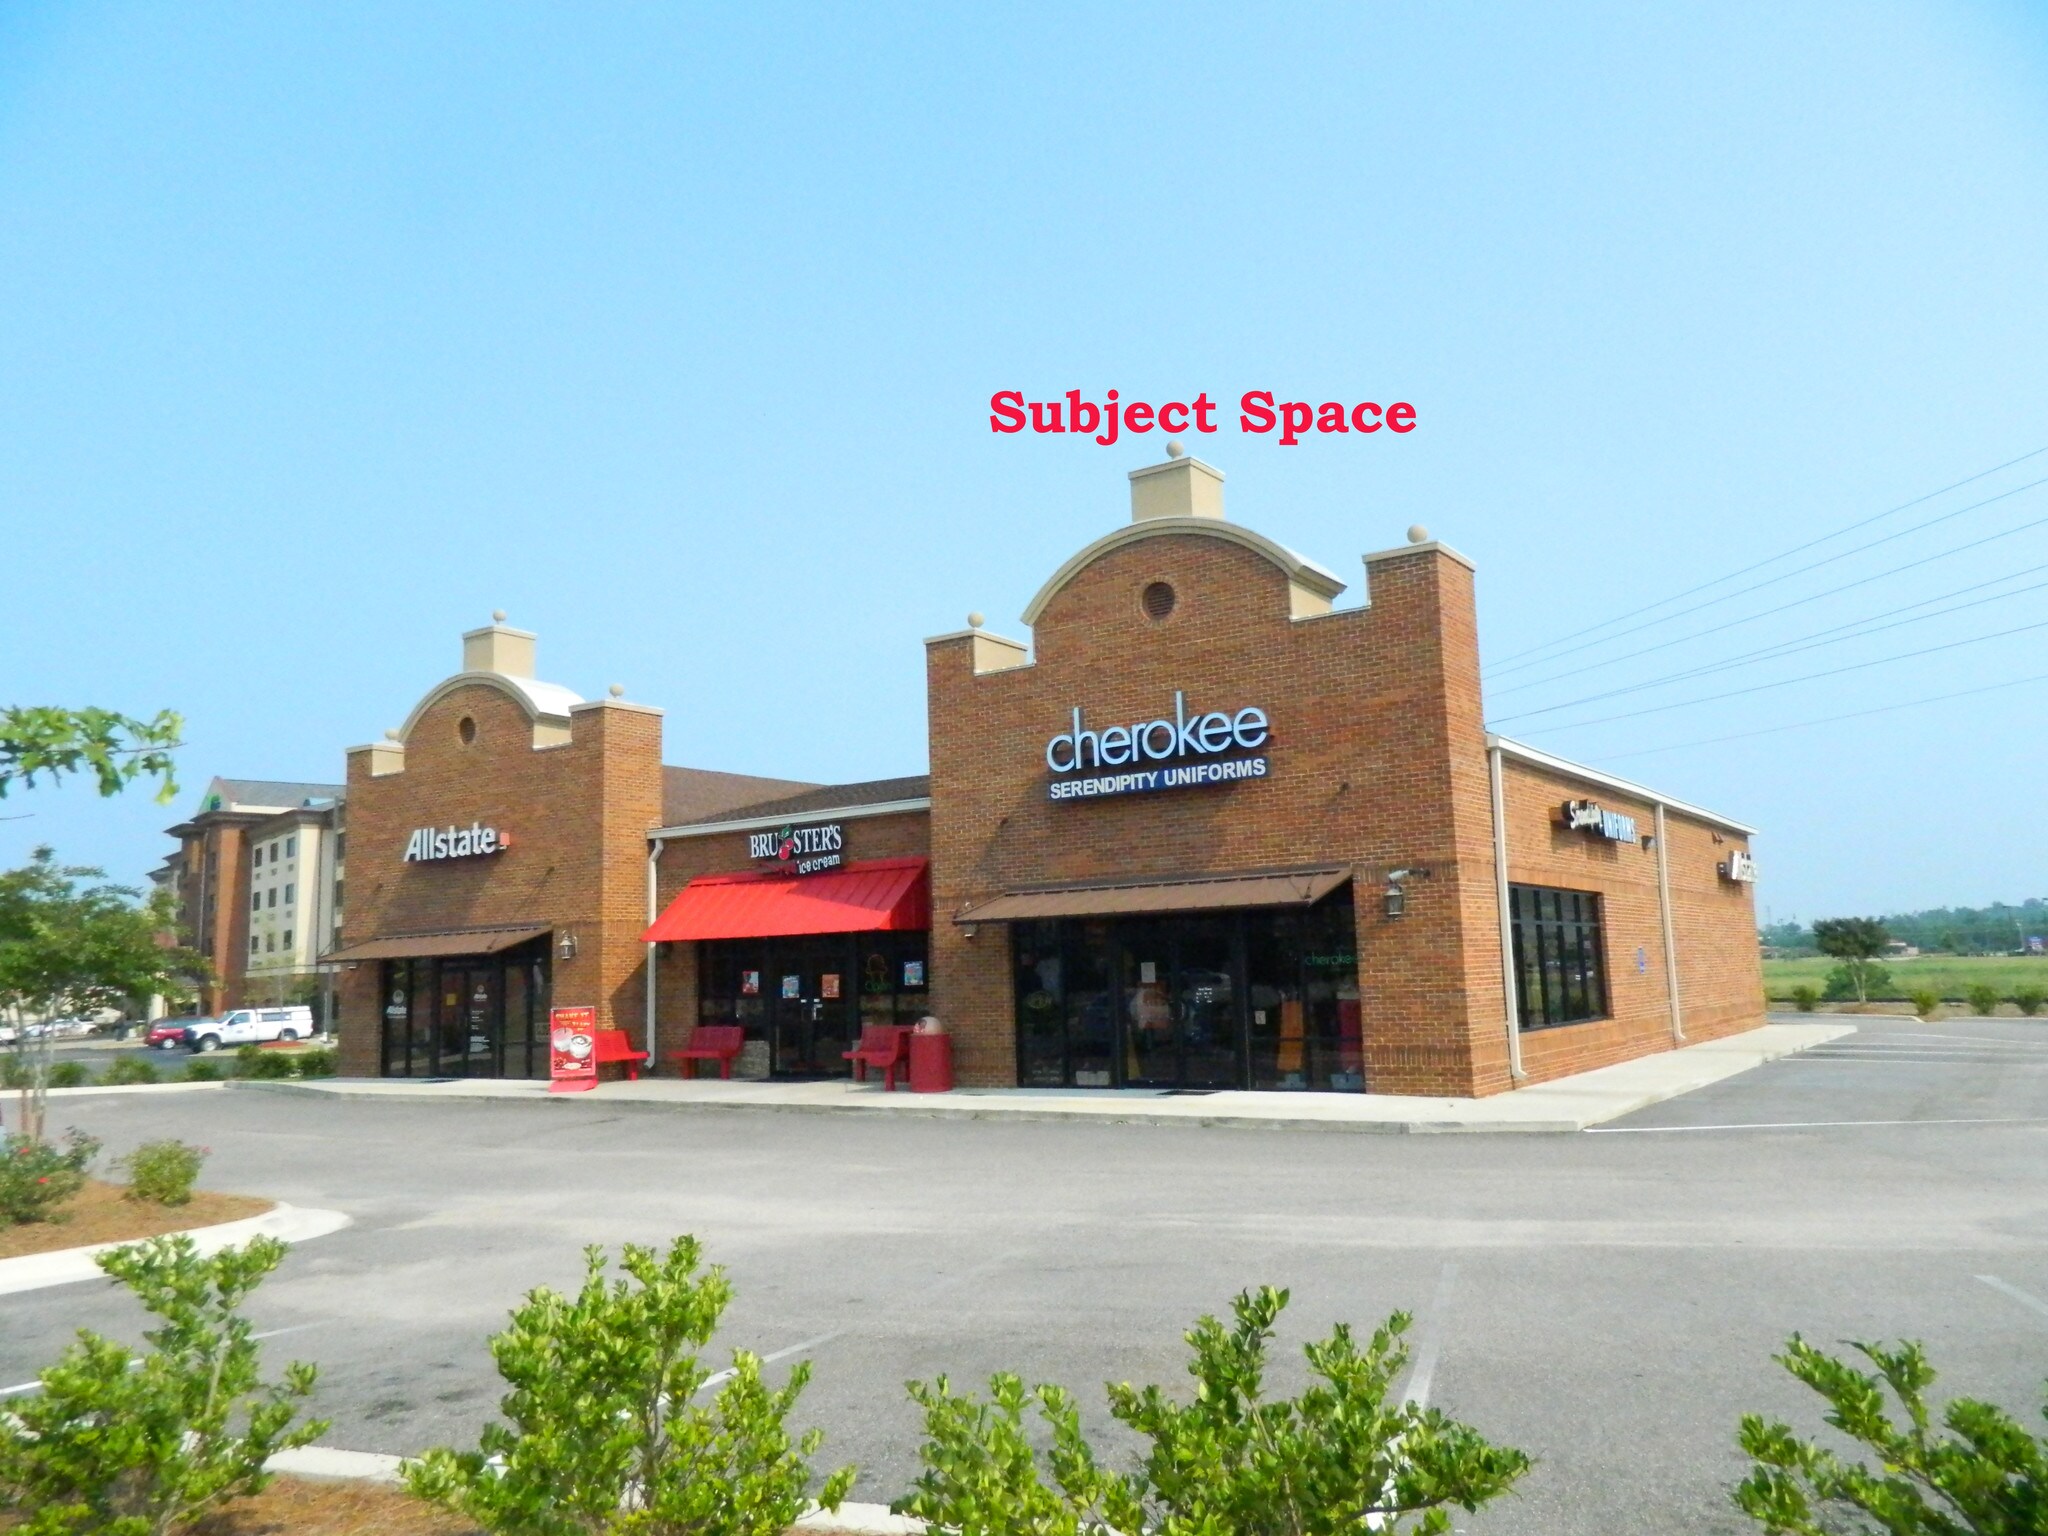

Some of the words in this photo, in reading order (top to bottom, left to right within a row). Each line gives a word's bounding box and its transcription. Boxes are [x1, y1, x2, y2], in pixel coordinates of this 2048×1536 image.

[1046, 690, 1268, 773] cherokee
[1050, 771, 1158, 800] SERENDIPITY
[1164, 758, 1267, 787] UNIFORMS
[403, 821, 496, 862] Allstate
[796, 860, 811, 874] ice
[812, 854, 840, 871] cream
